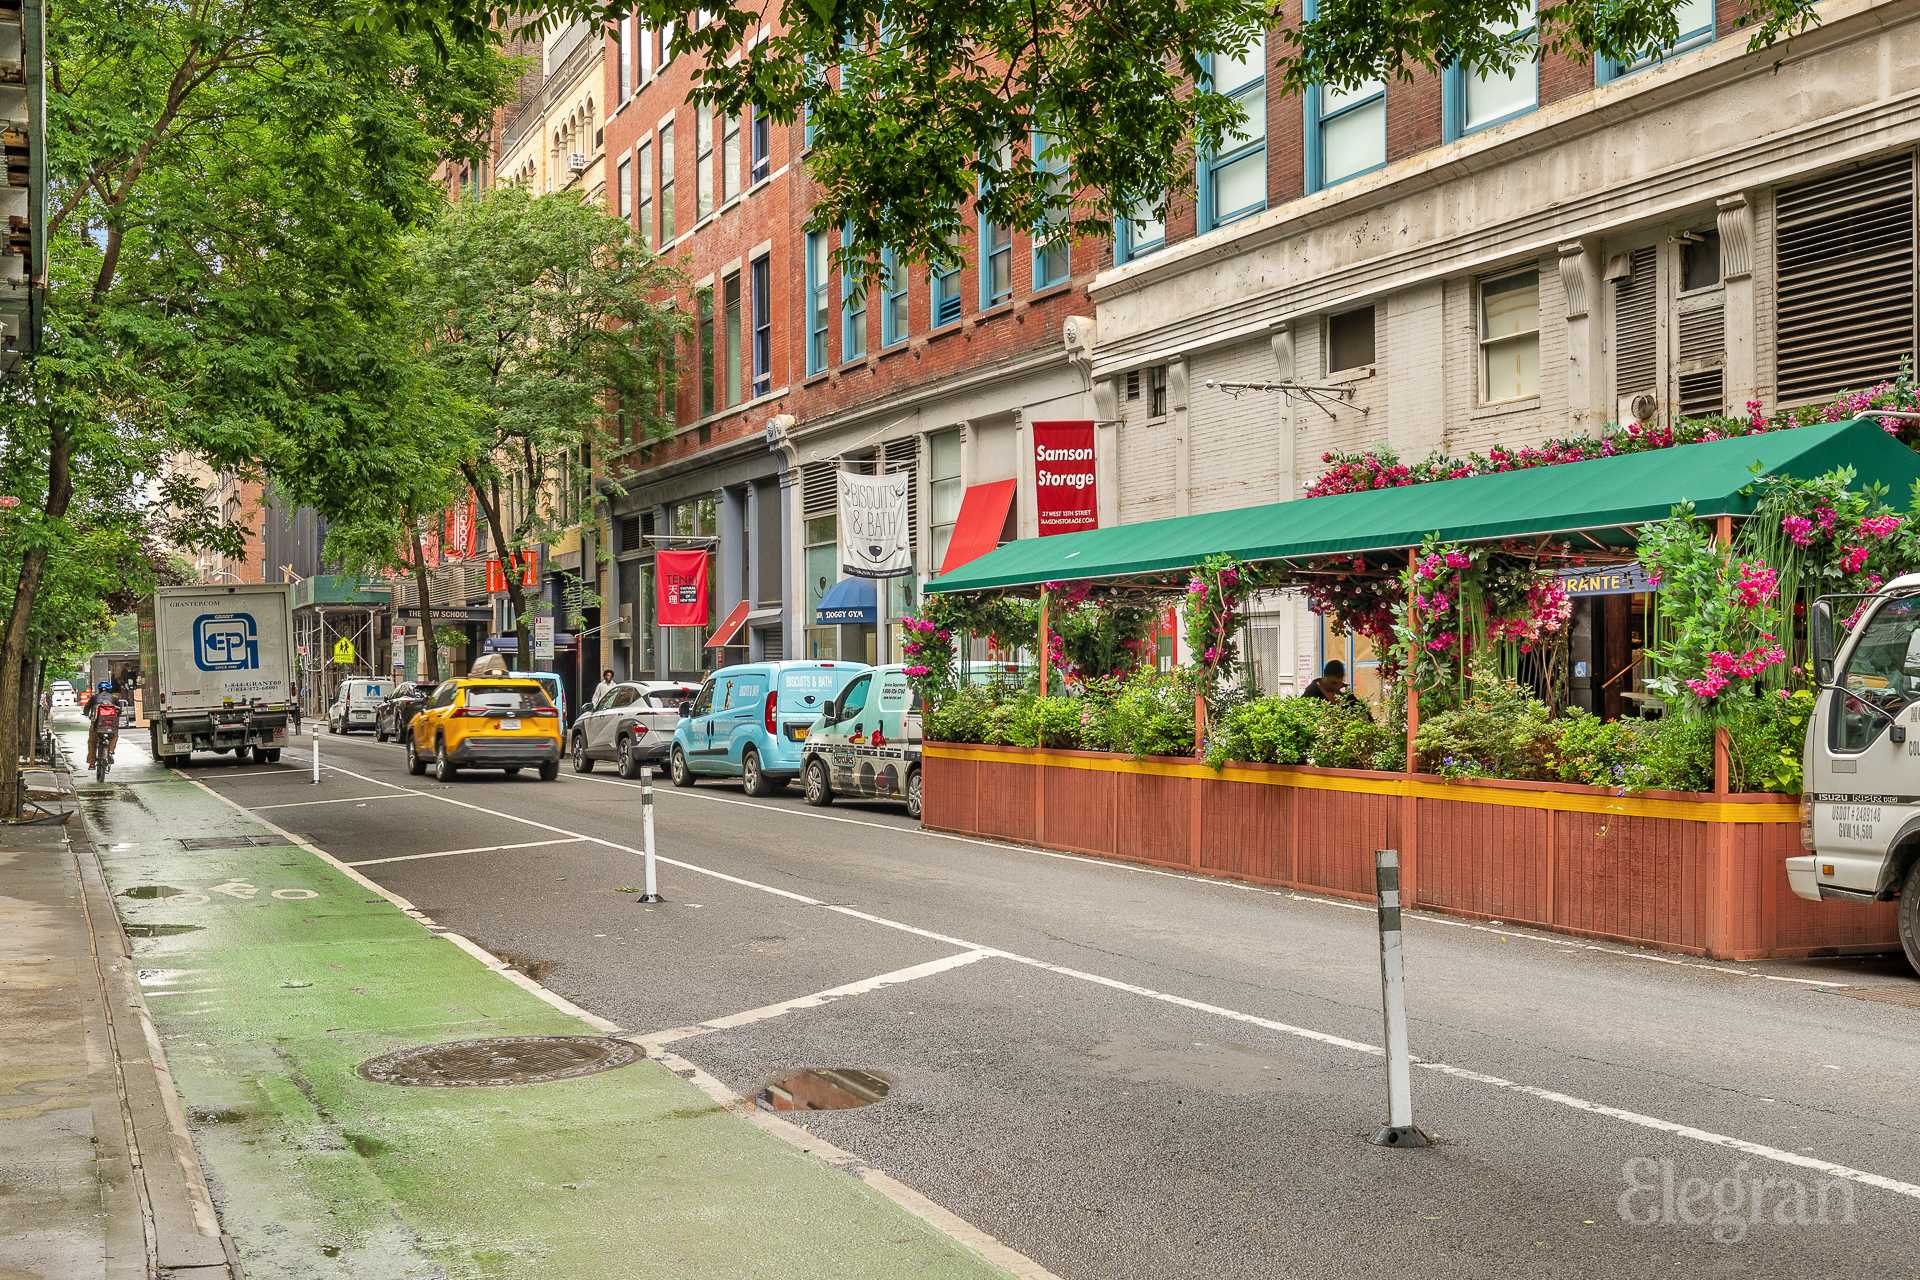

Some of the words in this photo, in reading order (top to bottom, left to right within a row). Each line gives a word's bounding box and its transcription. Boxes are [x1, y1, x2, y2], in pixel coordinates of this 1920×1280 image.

[1036, 444, 1093, 461] Samson
[1038, 470, 1094, 489] Storage
[850, 483, 896, 510] BISCUITS
[852, 510, 863, 535] &
[867, 510, 896, 537] BATH
[1567, 576, 1620, 592] RANTE
[826, 611, 847, 619] DOGGY
[848, 610, 864, 618] GYM
